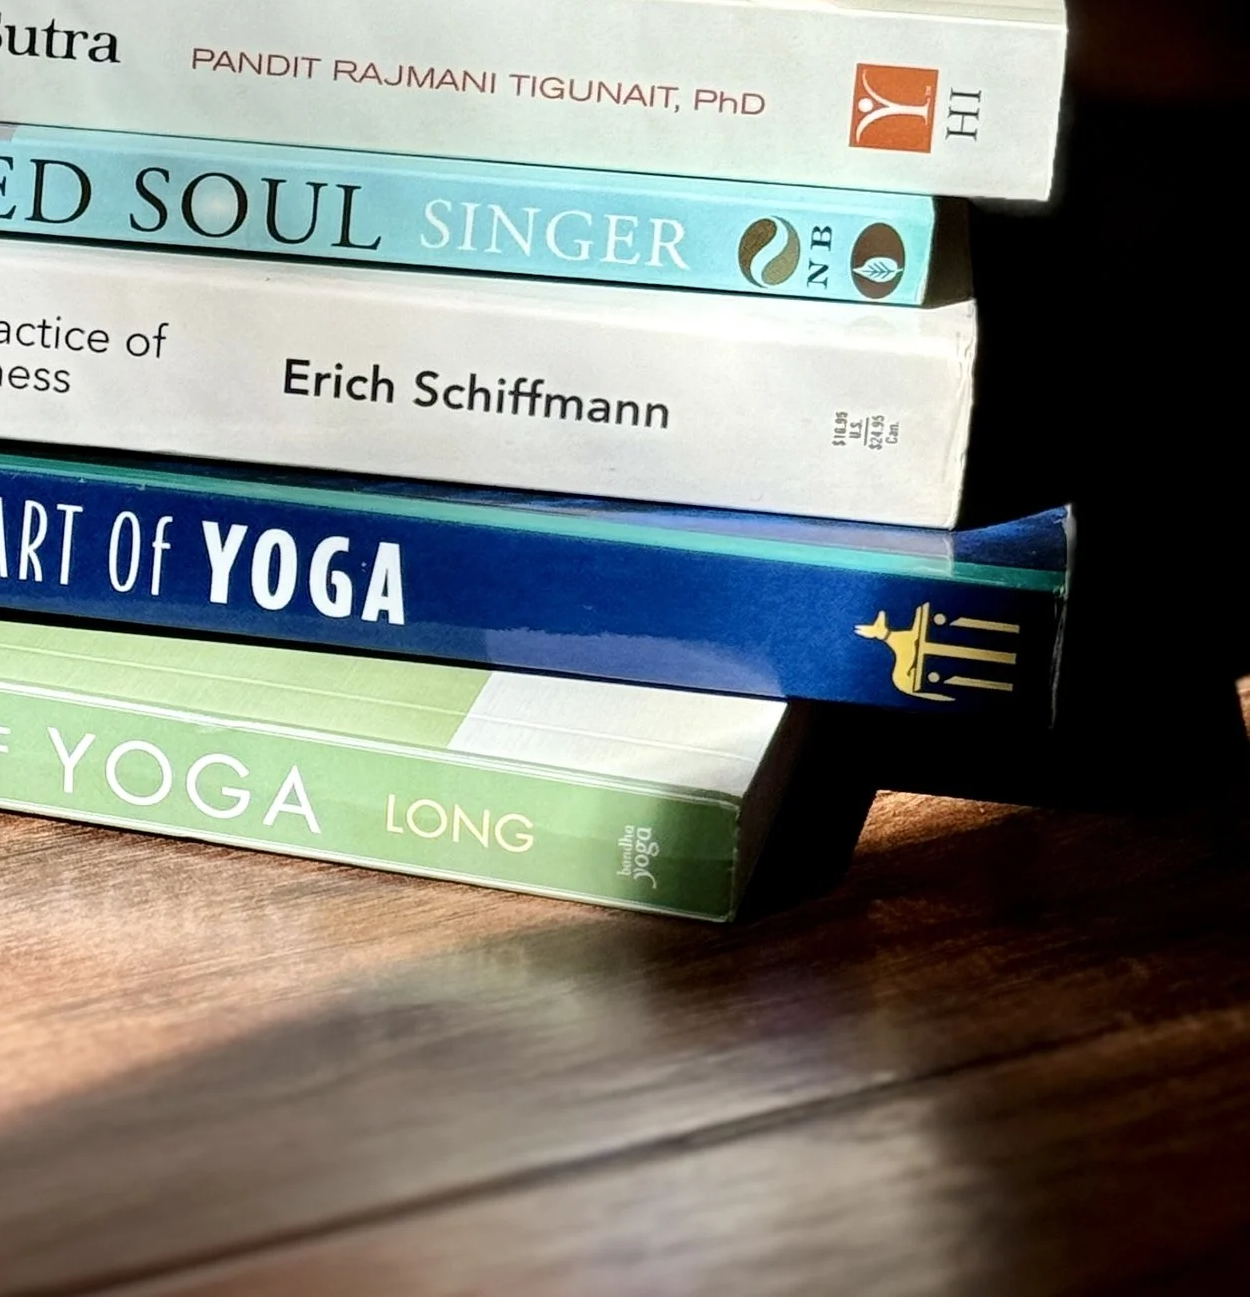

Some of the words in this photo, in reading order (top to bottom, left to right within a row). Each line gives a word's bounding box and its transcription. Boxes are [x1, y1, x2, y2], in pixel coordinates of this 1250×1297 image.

[191, 47, 321, 81] PANDIT
[332, 58, 497, 95] RAJMANI
[508, 72, 681, 113] TIGUNAIT,
[693, 87, 767, 116] PhD
[945, 86, 982, 142] HI
[128, 166, 382, 251] SOUL
[419, 198, 691, 270] SINGER
[125, 322, 170, 359] of
[283, 357, 395, 404] Erich
[412, 369, 670, 430] Schiffmann
[867, 414, 885, 451] $24.95
[885, 421, 899, 445] Can.
[201, 519, 405, 626] YOGA
[48, 726, 322, 835] YOGA
[385, 793, 534, 853] LONG
[615, 825, 635, 876] bandha
[633, 827, 661, 889] yoga
